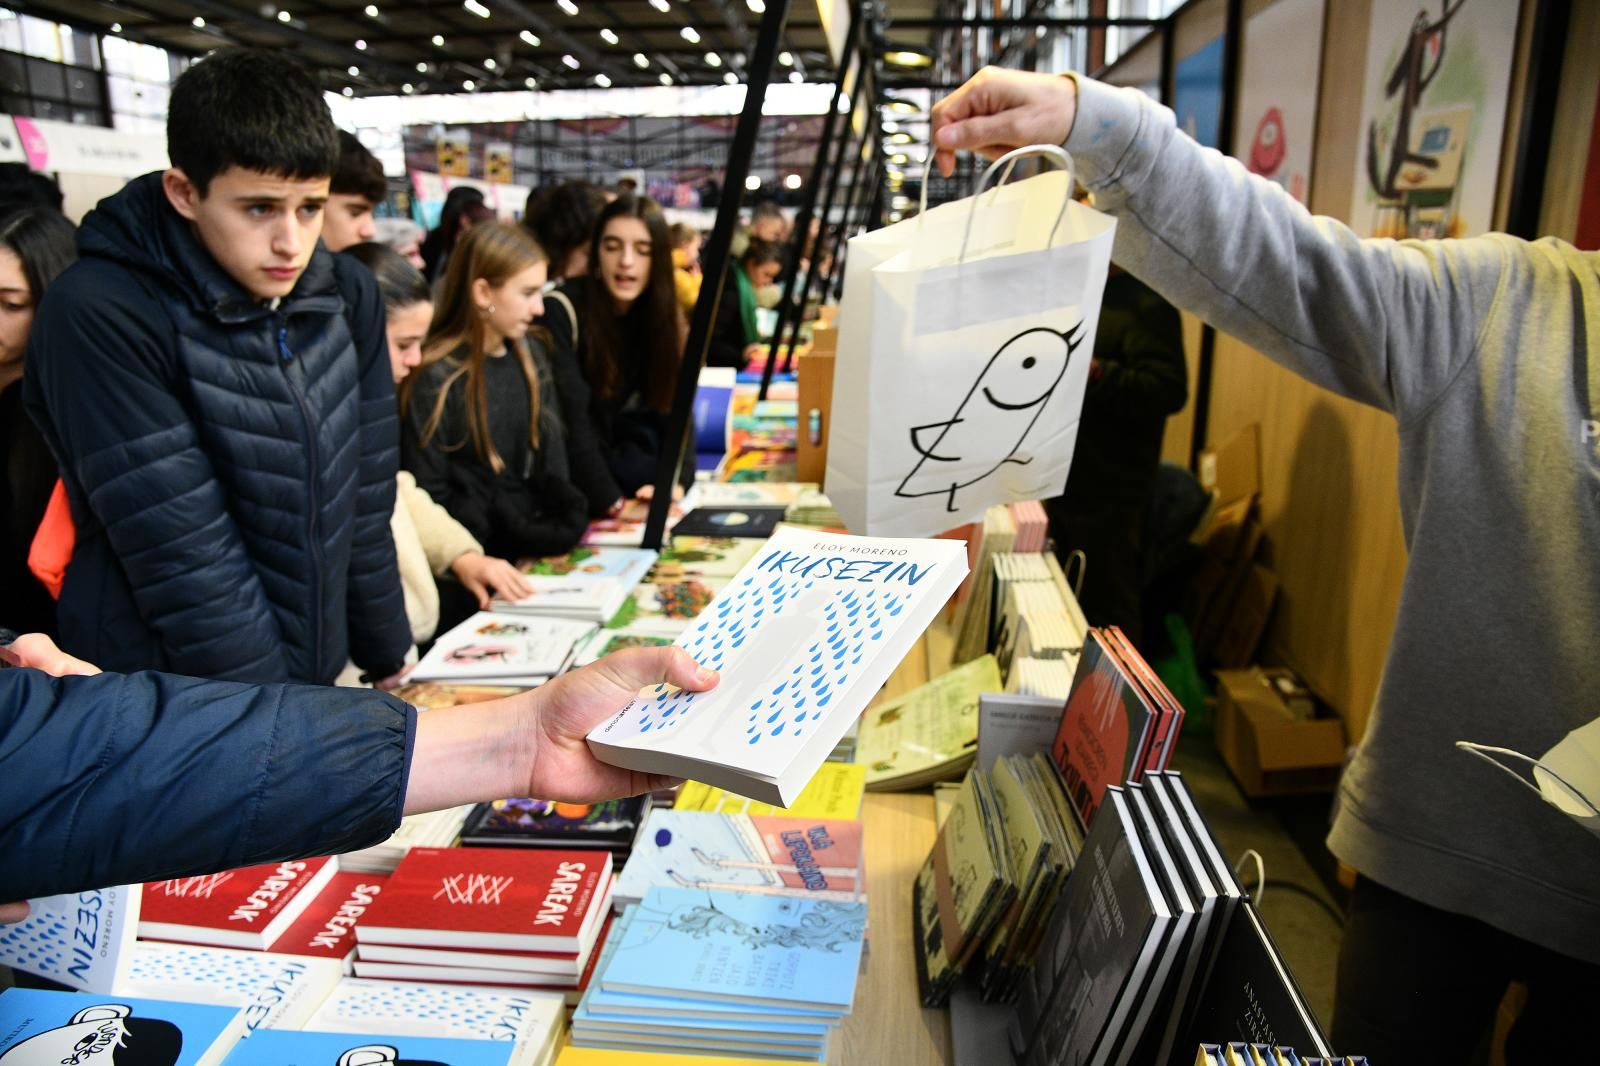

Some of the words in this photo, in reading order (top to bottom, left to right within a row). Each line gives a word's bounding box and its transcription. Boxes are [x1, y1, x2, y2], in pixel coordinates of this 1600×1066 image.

[757, 550, 936, 585] IKUSEZIN
[813, 543, 845, 552] ELOY
[850, 547, 908, 556] MORENO
[228, 862, 306, 922] SAREAK
[308, 884, 381, 948] SAREAK
[533, 862, 586, 926] SAREAK
[67, 890, 101, 983] SEZIN
[100, 911, 113, 958] MORENO
[241, 962, 306, 1039] IKUSE
[491, 998, 531, 1041] IKUS
[1243, 981, 1277, 1048] ANASTASI
[1244, 1008, 1263, 1043] ZIRK
